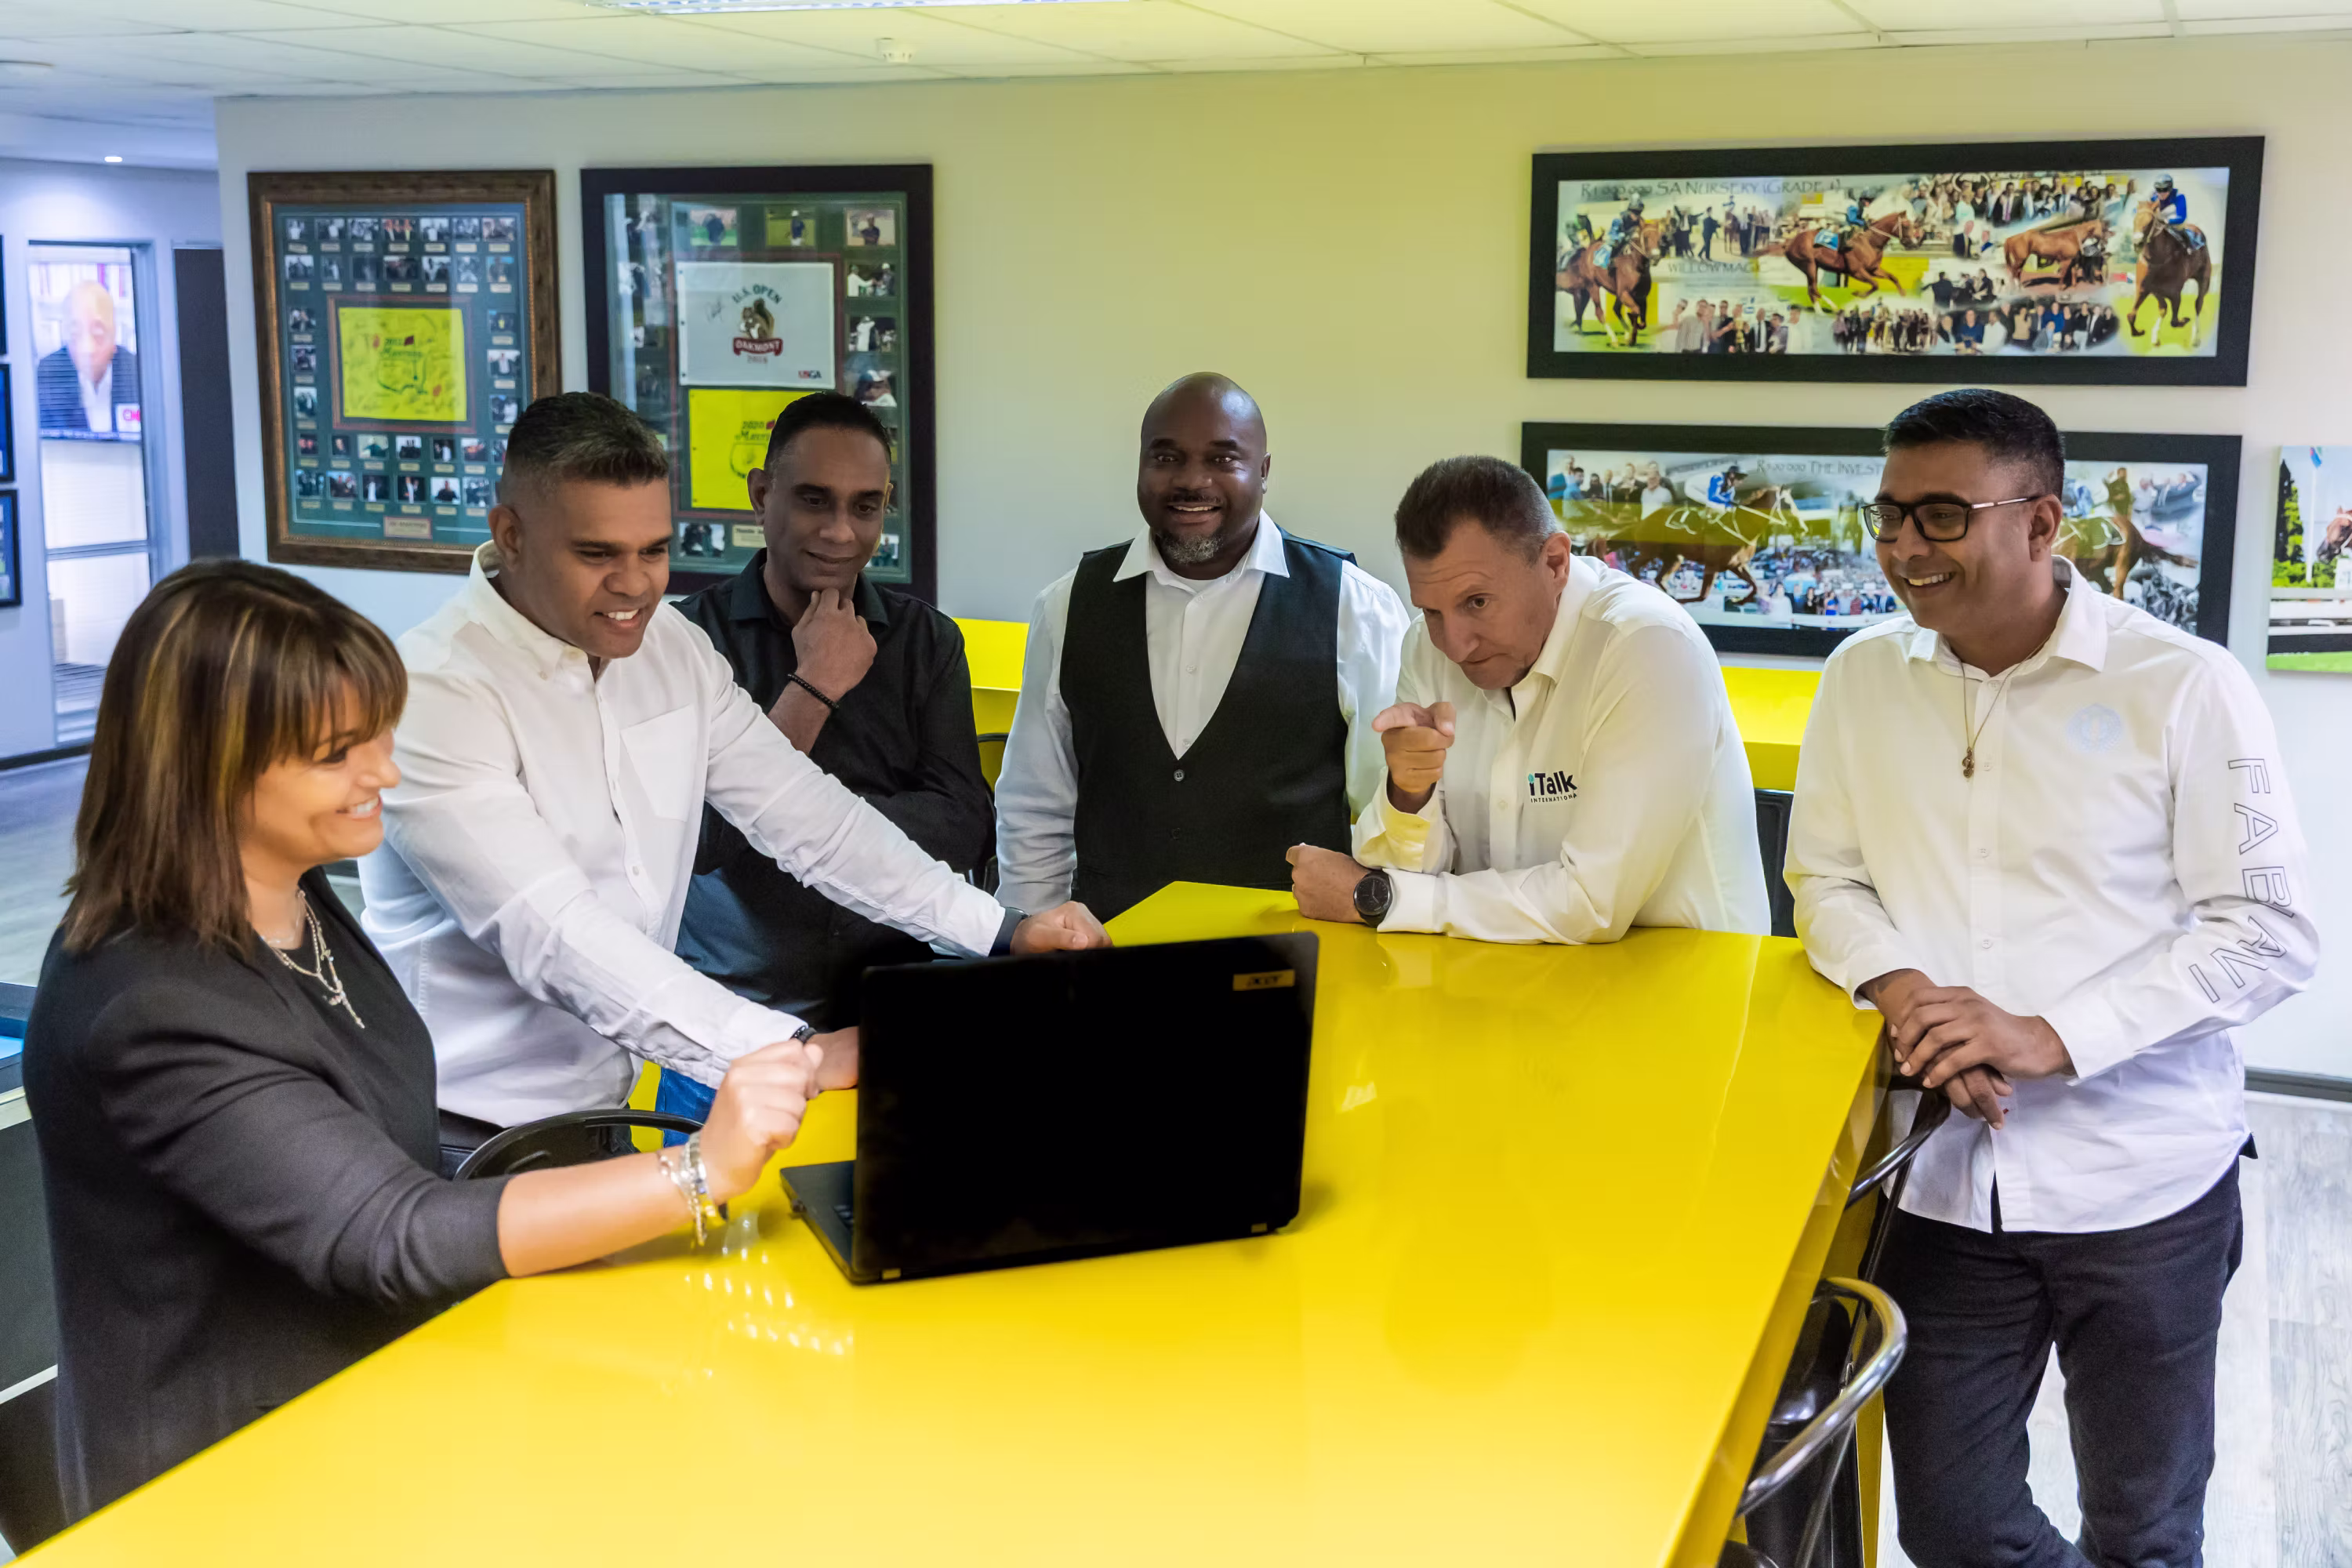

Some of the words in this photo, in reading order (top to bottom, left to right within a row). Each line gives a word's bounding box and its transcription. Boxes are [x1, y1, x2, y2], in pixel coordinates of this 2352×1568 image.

[753, 283, 783, 305] OPEN
[735, 339, 781, 352] OAKMONT
[1838, 461, 1885, 476] INVEST
[1527, 771, 1577, 797] iTalk
